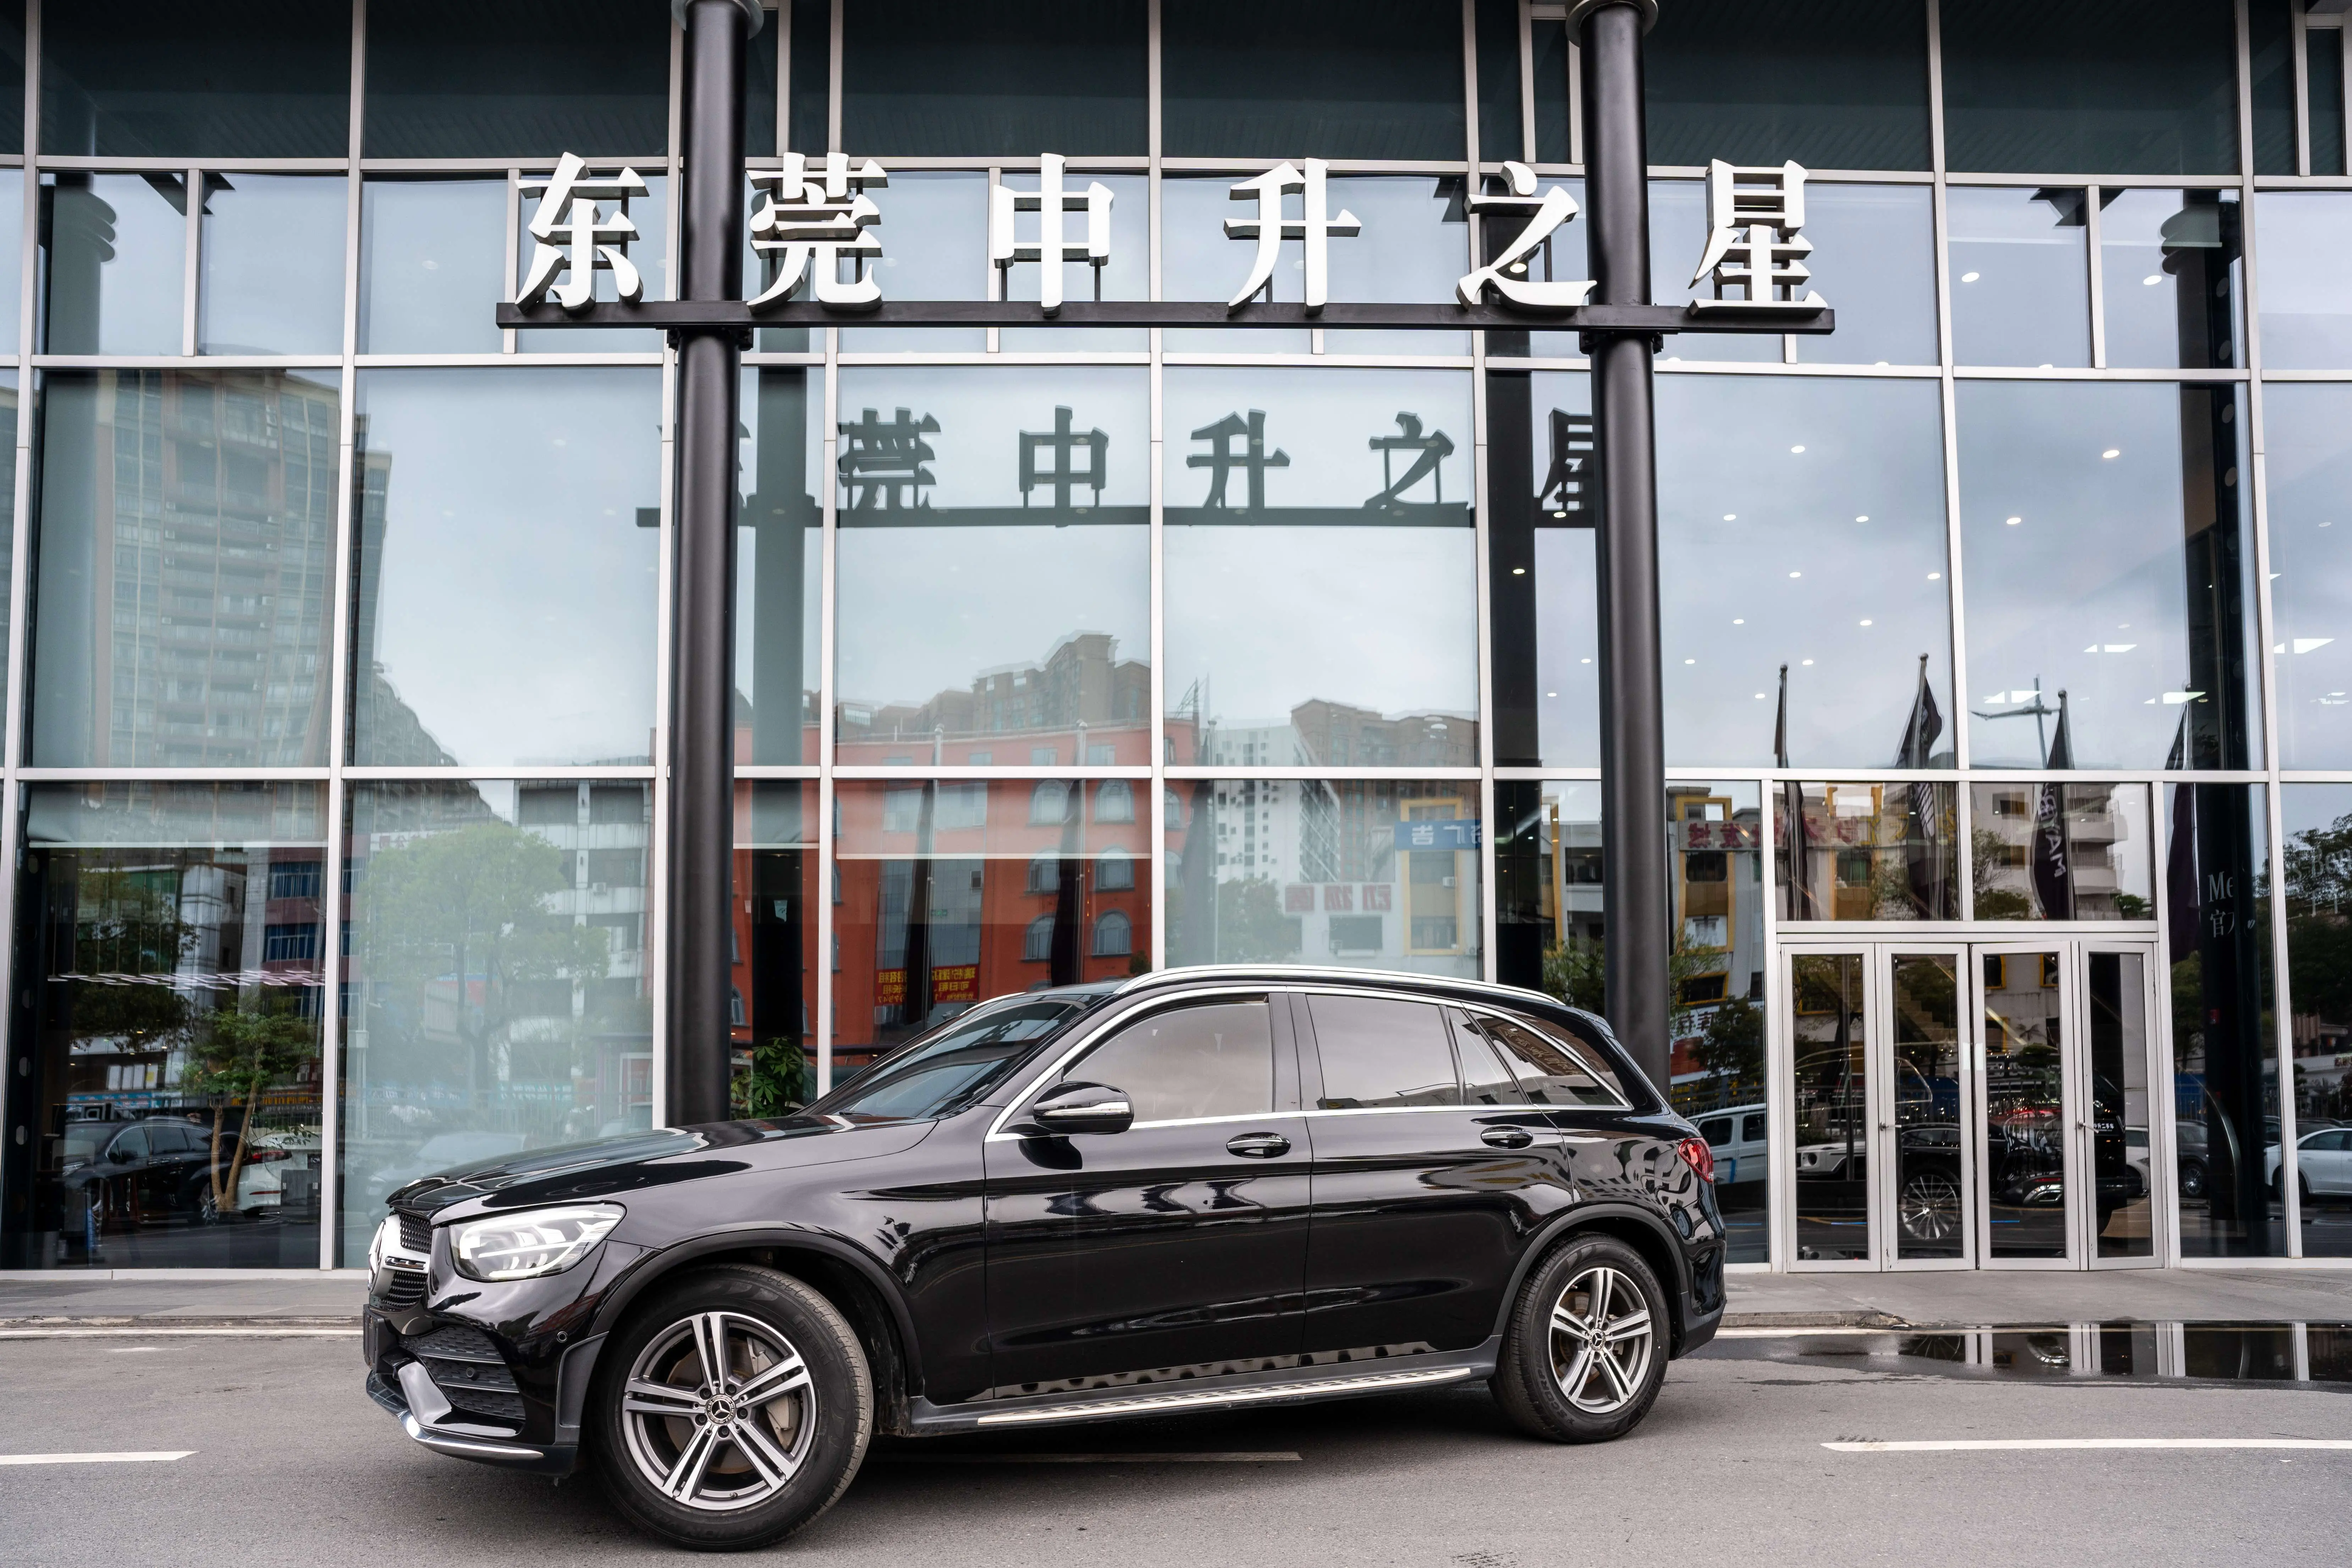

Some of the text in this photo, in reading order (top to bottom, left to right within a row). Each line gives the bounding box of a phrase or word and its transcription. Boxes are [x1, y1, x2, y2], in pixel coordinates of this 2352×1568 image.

[514, 152, 1828, 317] 东莞中升之星
[656, 406, 1594, 524] 莞中升之星
